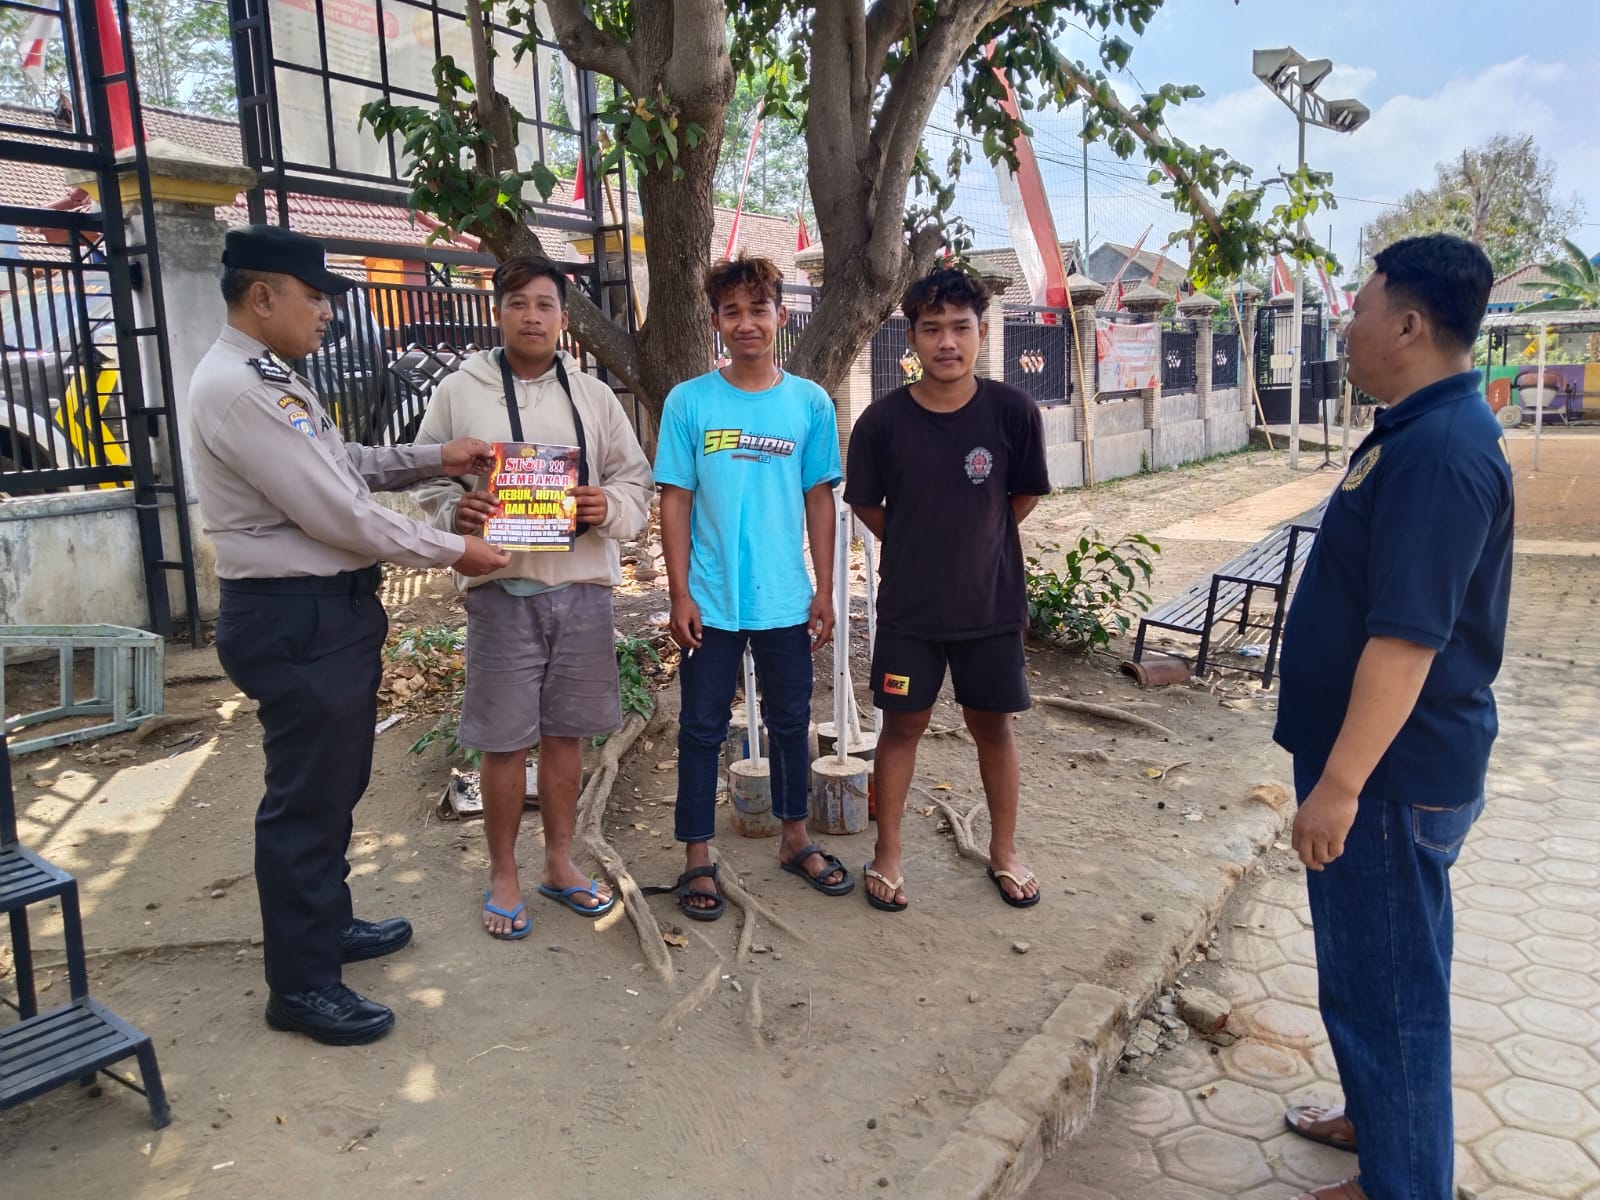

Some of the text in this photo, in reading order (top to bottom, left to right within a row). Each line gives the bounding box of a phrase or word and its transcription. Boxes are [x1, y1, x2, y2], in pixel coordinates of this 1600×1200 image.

[738, 434, 797, 456] AUDIO
[505, 457, 546, 472] STOP
[496, 473, 570, 486] MEMBAKAR
[498, 489, 533, 502] KEBUN,
[504, 503, 561, 515] DAN LAHAN
